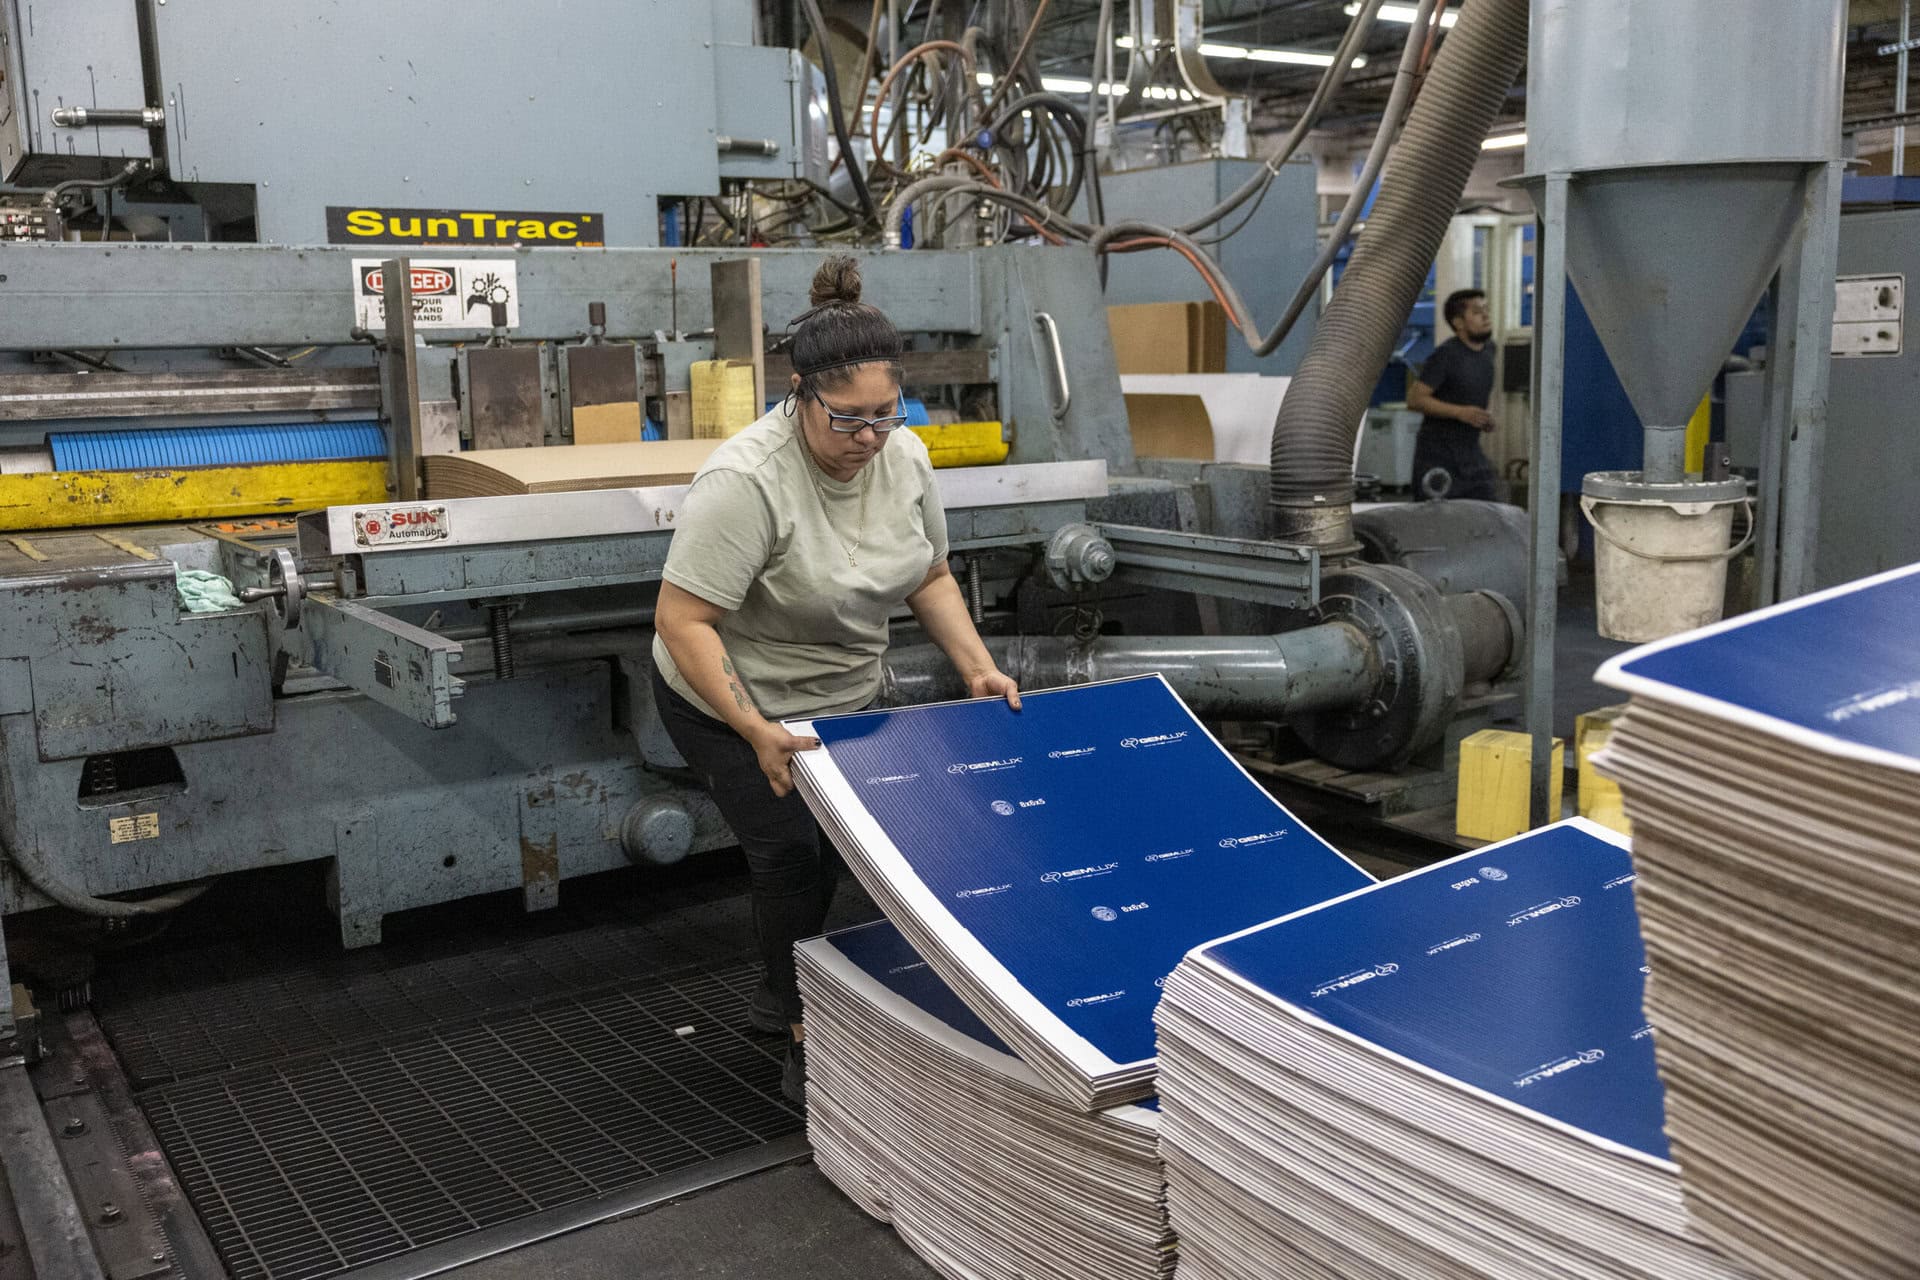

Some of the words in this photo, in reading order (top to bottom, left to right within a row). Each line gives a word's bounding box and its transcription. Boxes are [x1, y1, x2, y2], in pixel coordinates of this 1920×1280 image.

[346, 210, 578, 239] SunTrac
[372, 273, 447, 289] DGER
[392, 511, 437, 526] SUN
